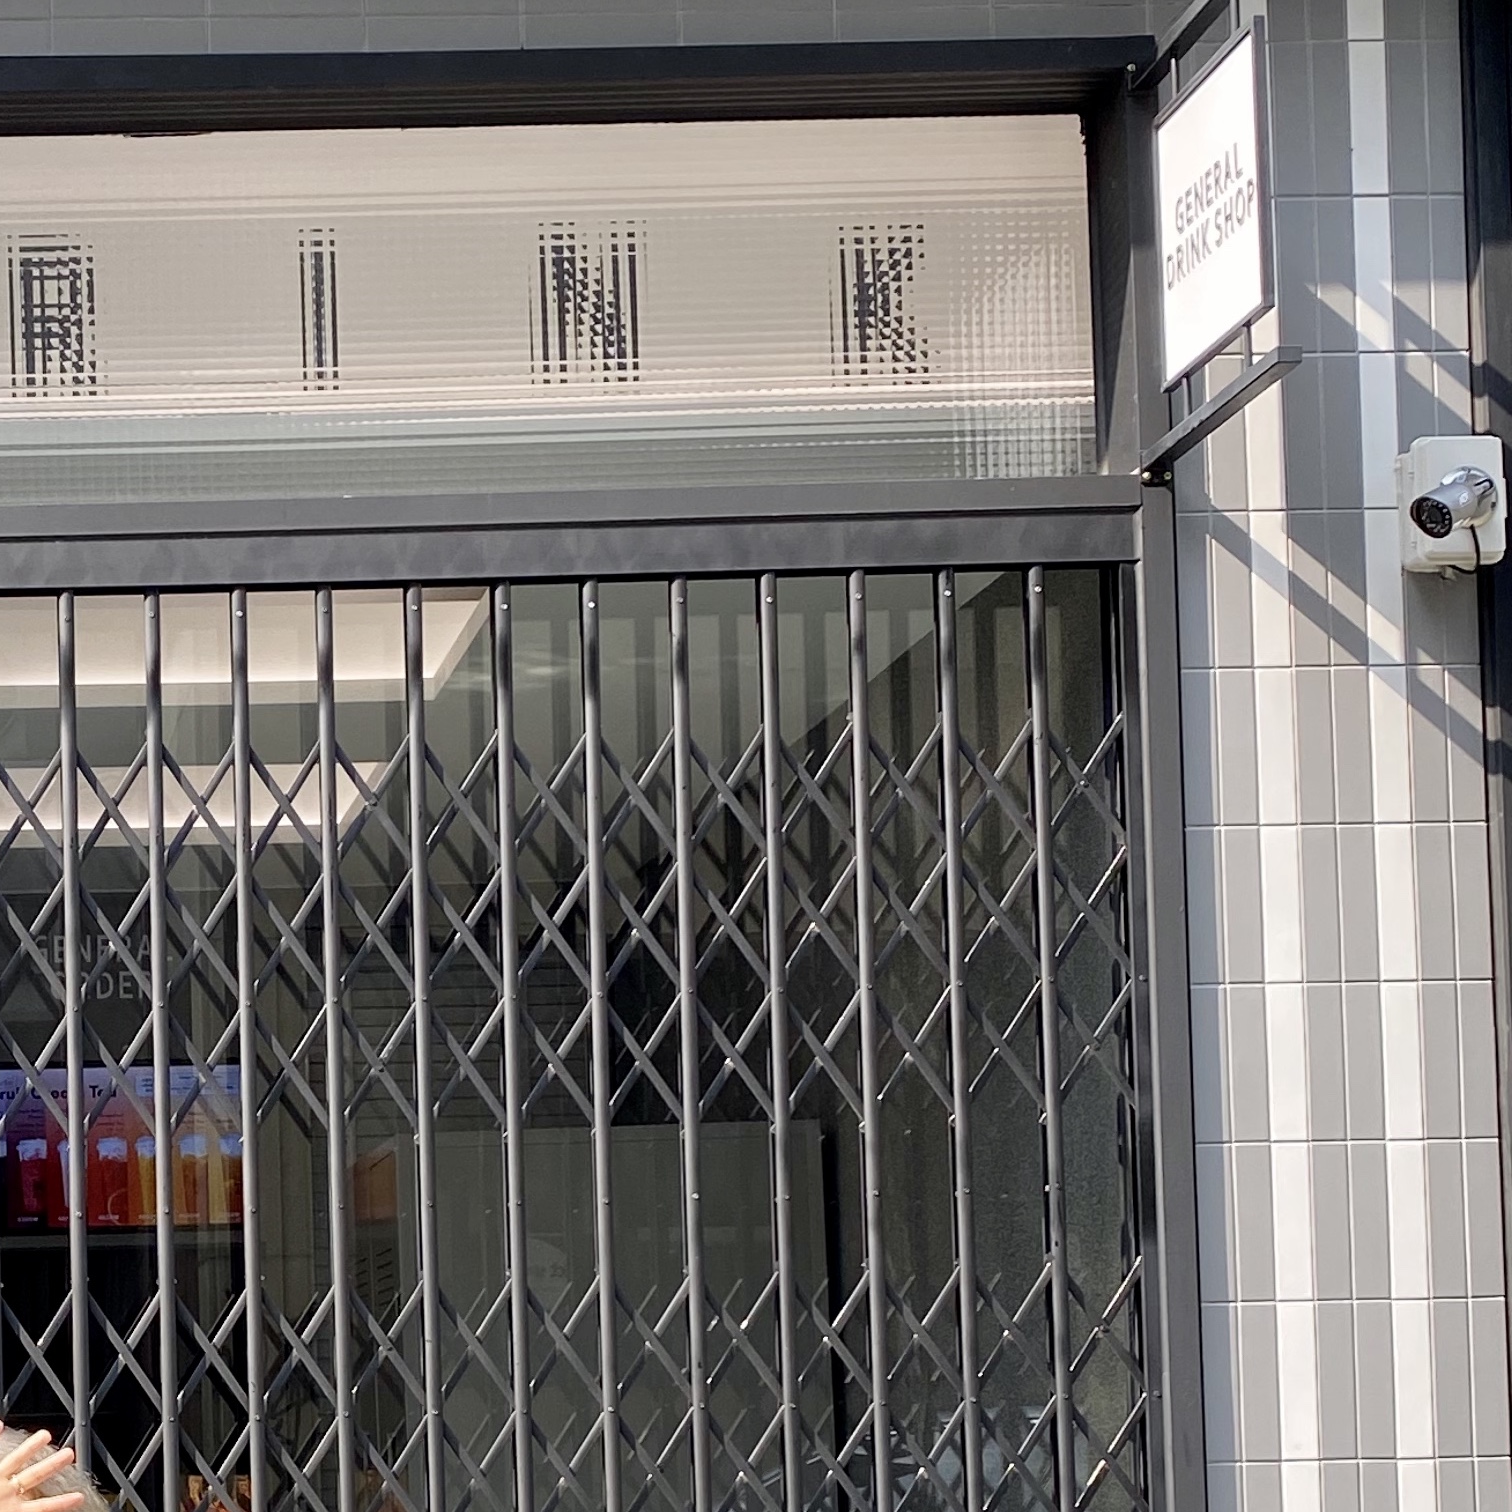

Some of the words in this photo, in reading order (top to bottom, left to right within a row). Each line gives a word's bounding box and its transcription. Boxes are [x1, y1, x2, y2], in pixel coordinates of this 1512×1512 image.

[1166, 217, 1212, 292] DRINK
[1214, 178, 1255, 248] SHOP
[1175, 142, 1244, 235] GENERAL
